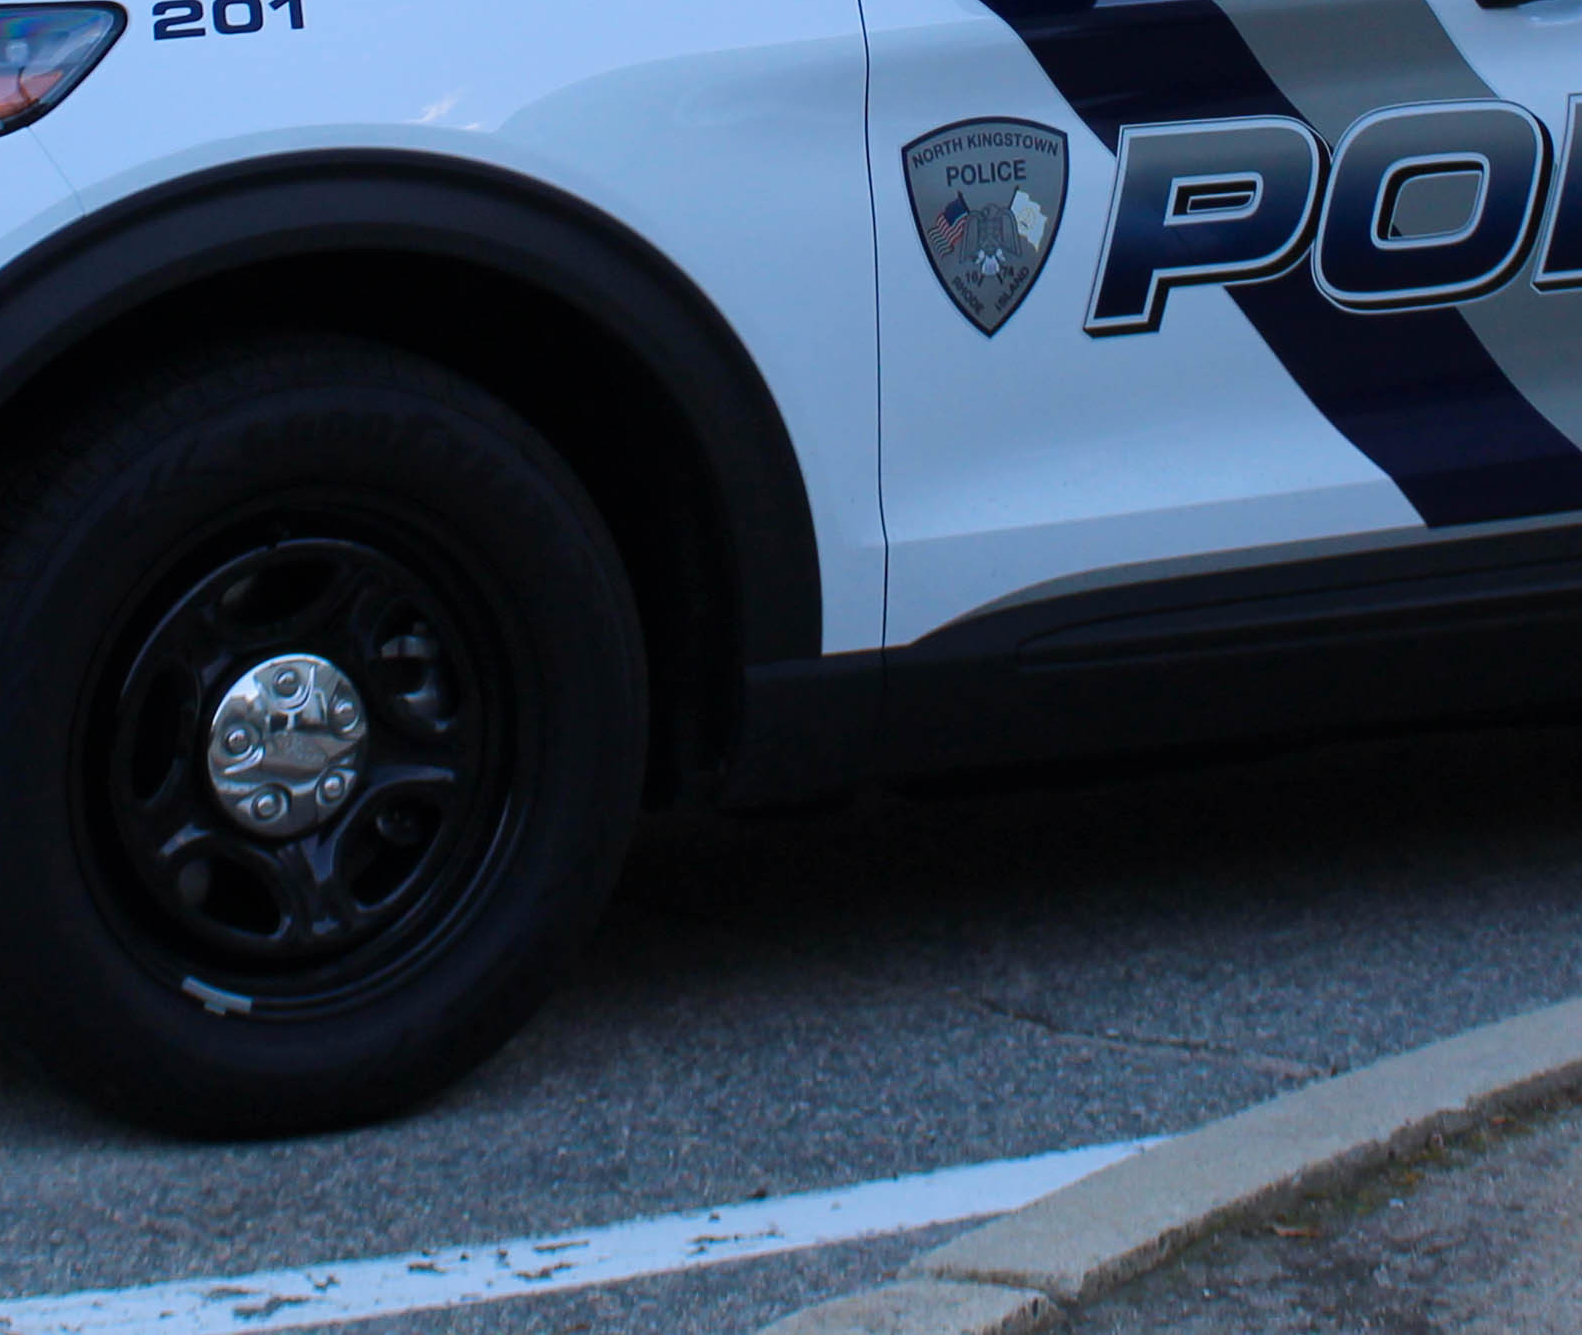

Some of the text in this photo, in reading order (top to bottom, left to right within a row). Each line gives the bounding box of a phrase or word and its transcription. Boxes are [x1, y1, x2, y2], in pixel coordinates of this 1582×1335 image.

[912, 132, 1059, 170] NORTH KINGSTOWN
[946, 159, 1027, 188] POLICE
[952, 275, 985, 314] RHODE
[994, 266, 1031, 313] ISLAND
